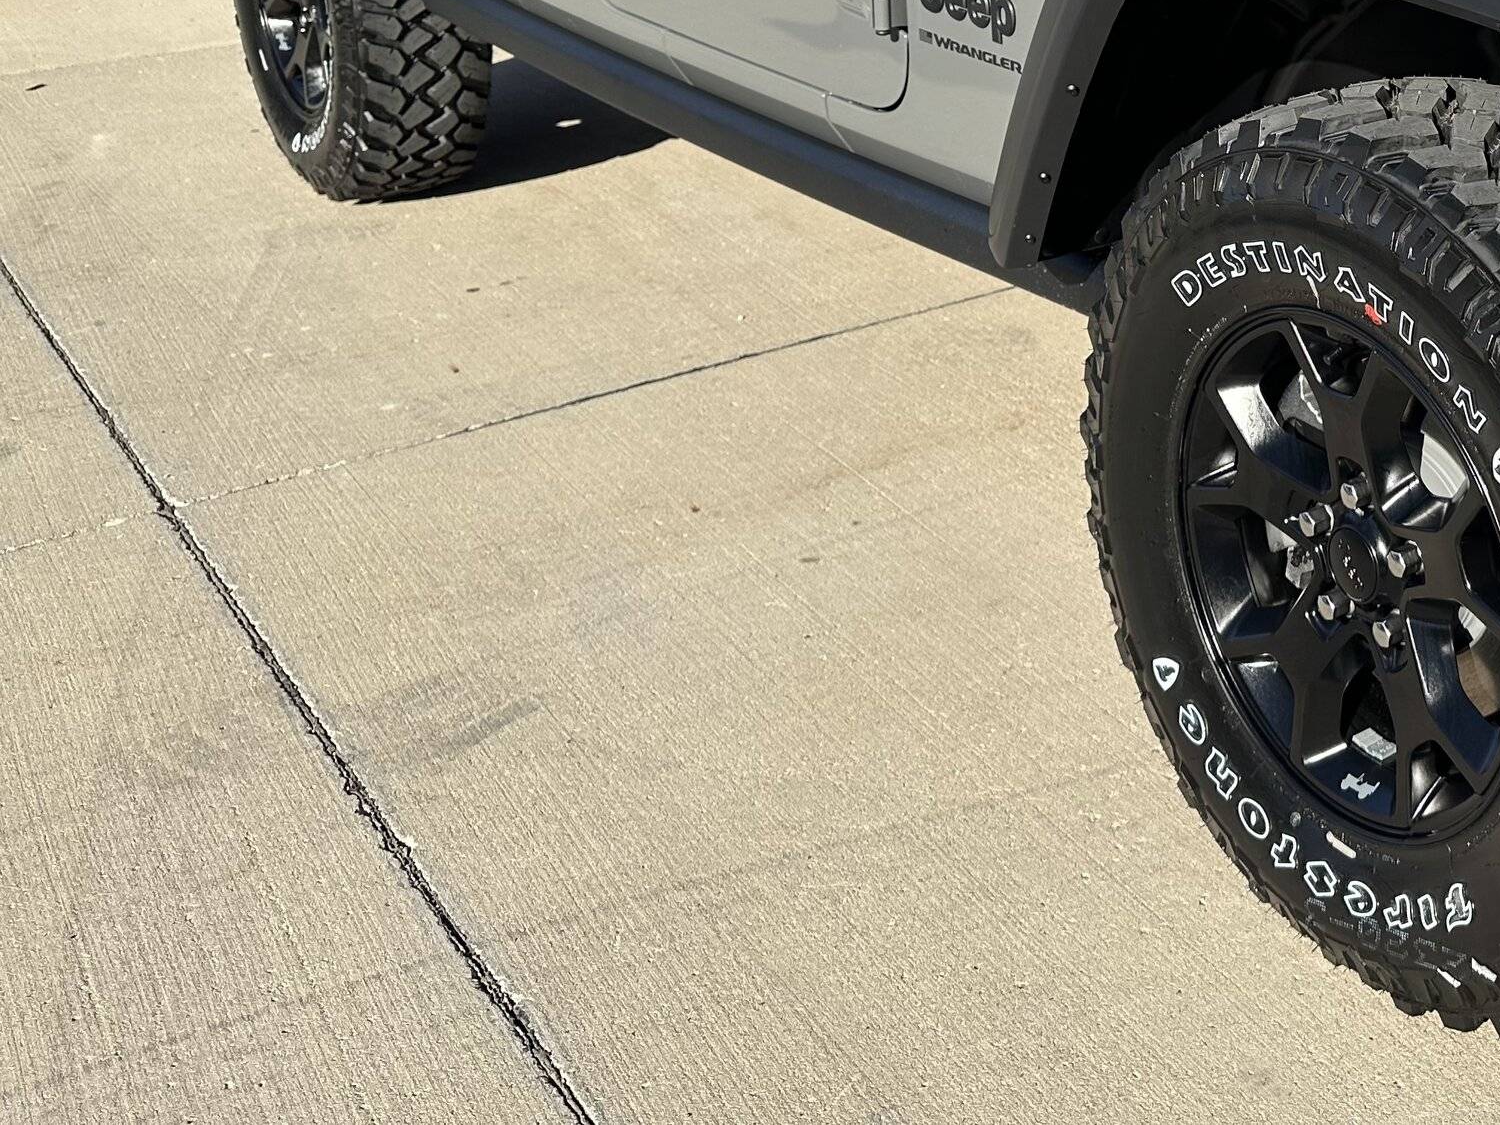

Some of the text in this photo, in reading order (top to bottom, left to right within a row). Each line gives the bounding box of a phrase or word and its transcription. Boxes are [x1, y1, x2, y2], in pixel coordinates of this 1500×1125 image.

[933, 33, 1023, 75] WRANGLER
[1171, 240, 1487, 434] DESTINATION
[1178, 703, 1474, 933] Firestone
